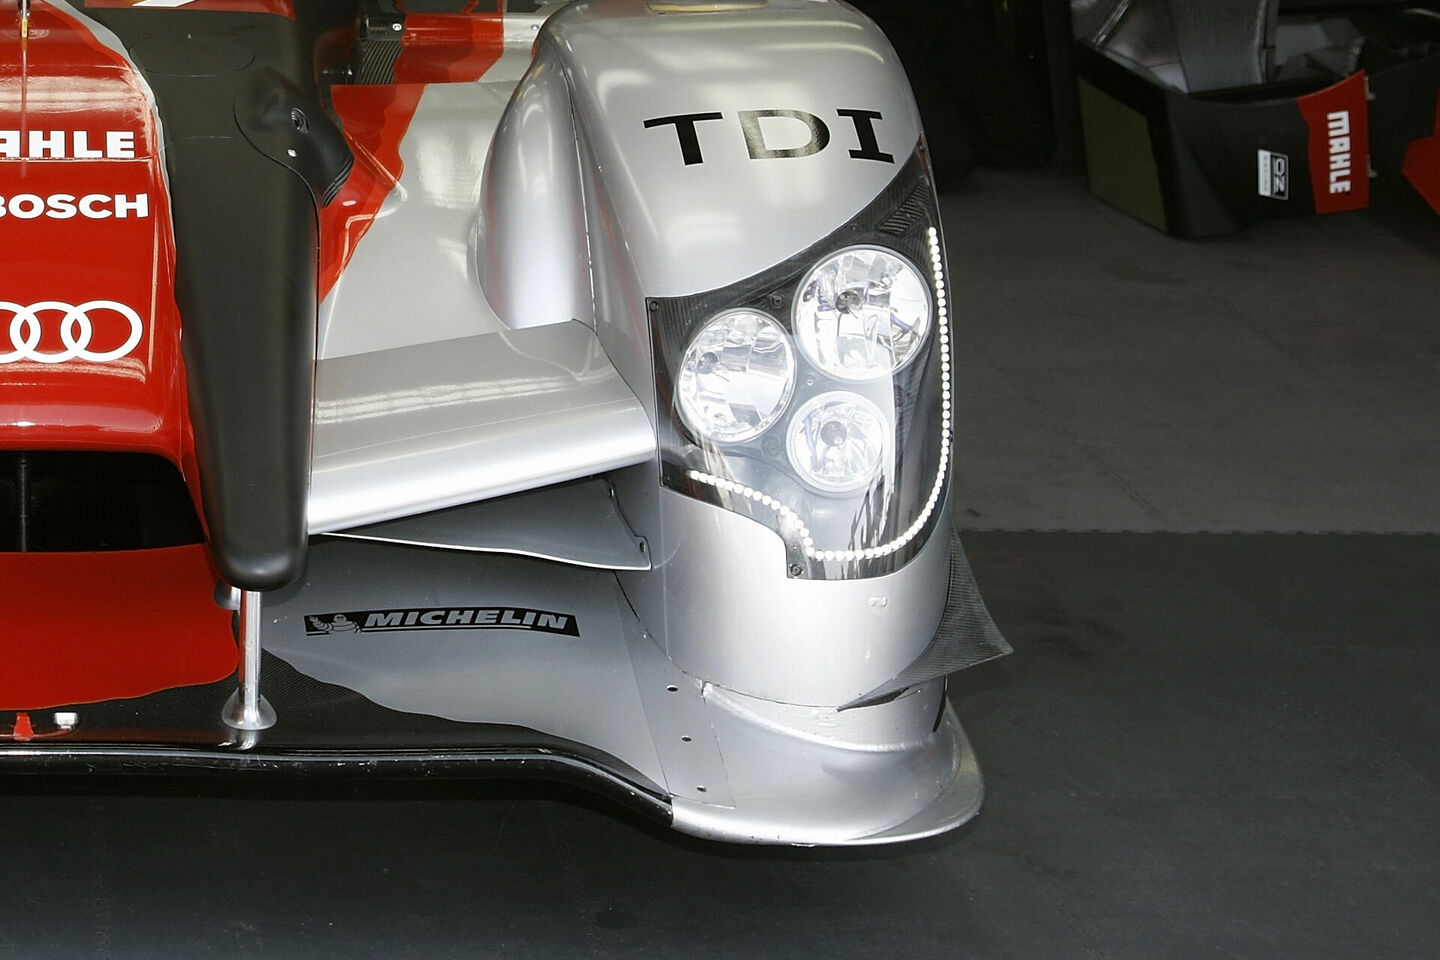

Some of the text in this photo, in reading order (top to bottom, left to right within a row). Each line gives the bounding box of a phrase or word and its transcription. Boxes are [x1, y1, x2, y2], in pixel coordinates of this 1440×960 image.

[643, 108, 894, 166] TDI
[1327, 110, 1351, 194] MAHLE
[364, 610, 568, 629] MICHELIN
